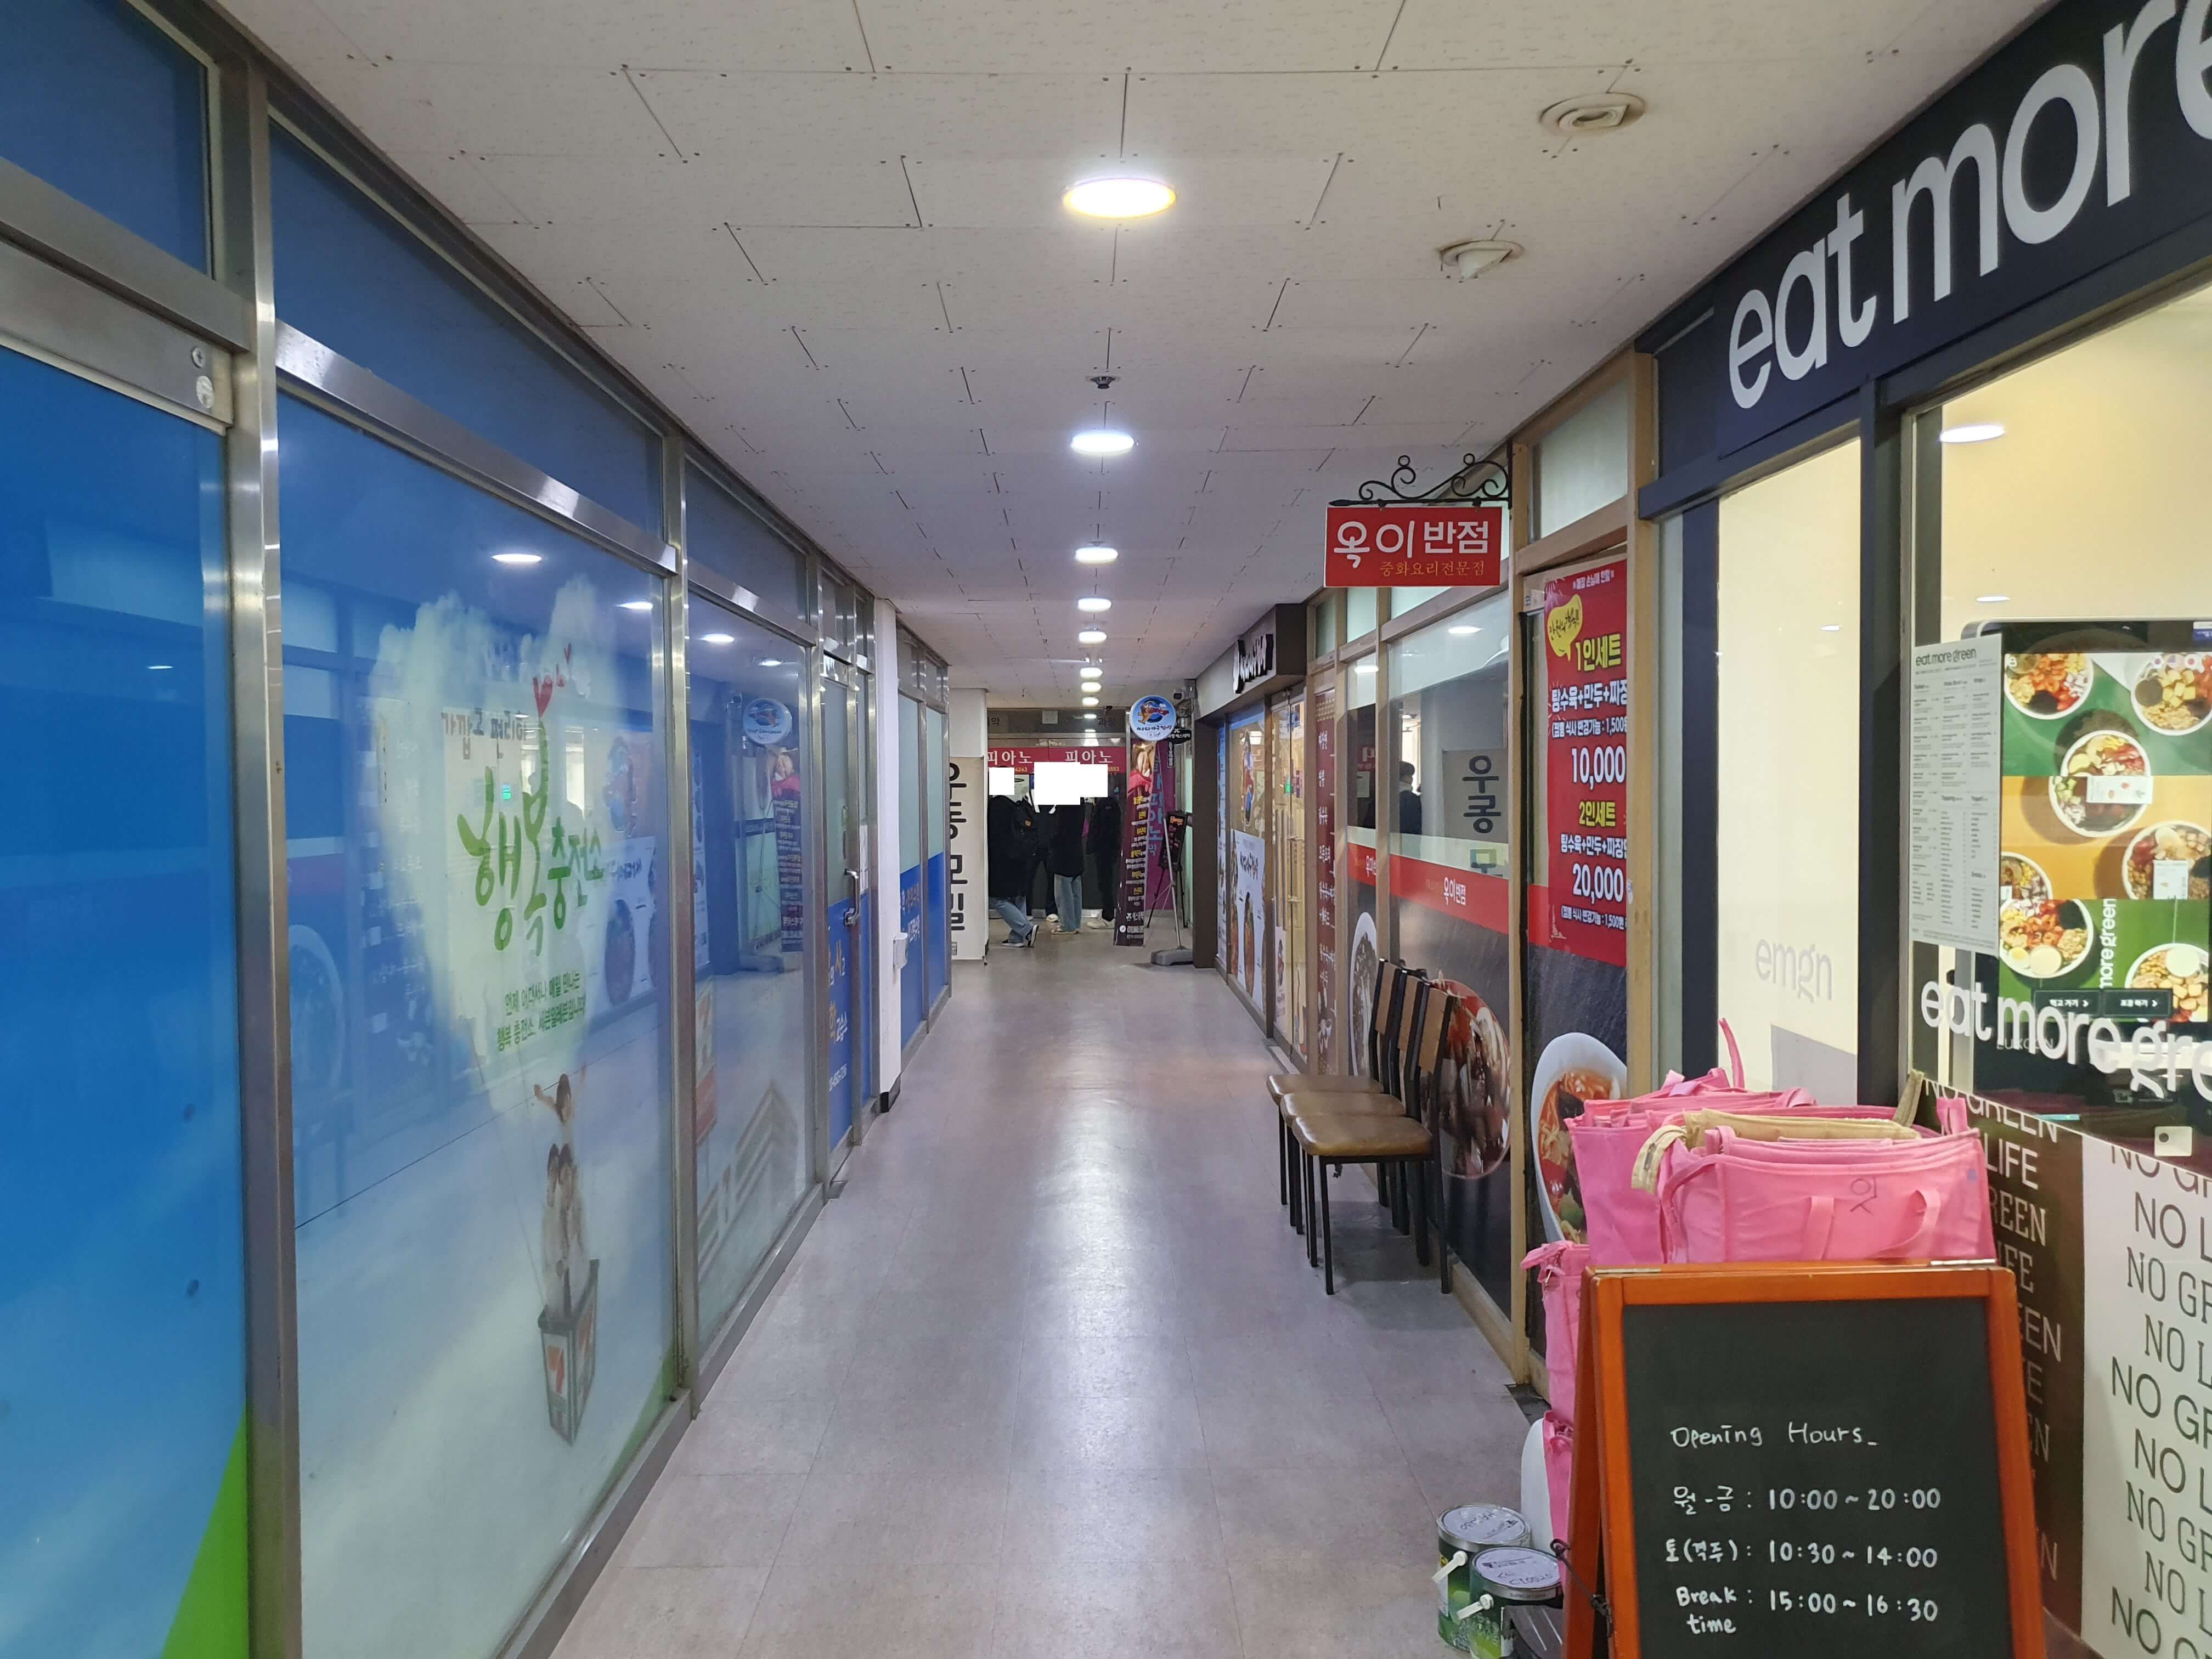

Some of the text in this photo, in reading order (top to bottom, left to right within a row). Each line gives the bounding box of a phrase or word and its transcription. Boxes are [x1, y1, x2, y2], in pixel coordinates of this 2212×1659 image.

[1729, 193, 1876, 409] eat
[1334, 520, 1488, 568] 옥이반점
[1380, 560, 1485, 577] 중화요리전문점
[1575, 633, 1621, 672] 1인세트
[1916, 648, 1977, 666] eat more green
[1065, 749, 1113, 765] 피아노
[1572, 745, 1626, 791] 10,000
[1579, 801, 1616, 827] 2인세트
[1561, 833, 1627, 860] 탕수육+만두+짜장
[1443, 877, 1466, 906] 옥이반점
[1572, 862, 1624, 904] 20,000
[2099, 898, 2118, 947] green
[1756, 939, 1832, 1003] emgn
[1921, 978, 1993, 1042] eat
[1997, 996, 2121, 1074] more
[1989, 1185, 2046, 1246] REEN
[2135, 1190, 2186, 1249] NO
[2126, 1246, 2166, 1302] NO
[2145, 1313, 2185, 1372] NO
[2112, 1356, 2161, 1418] NO
[1671, 1424, 1763, 1449] Opening
[2135, 1427, 2186, 1493] NO
[2126, 1480, 2165, 1542] NO
[2145, 1550, 2185, 1615] NO
[1686, 1614, 1736, 1635] time
[2112, 1586, 2161, 1654] NO
